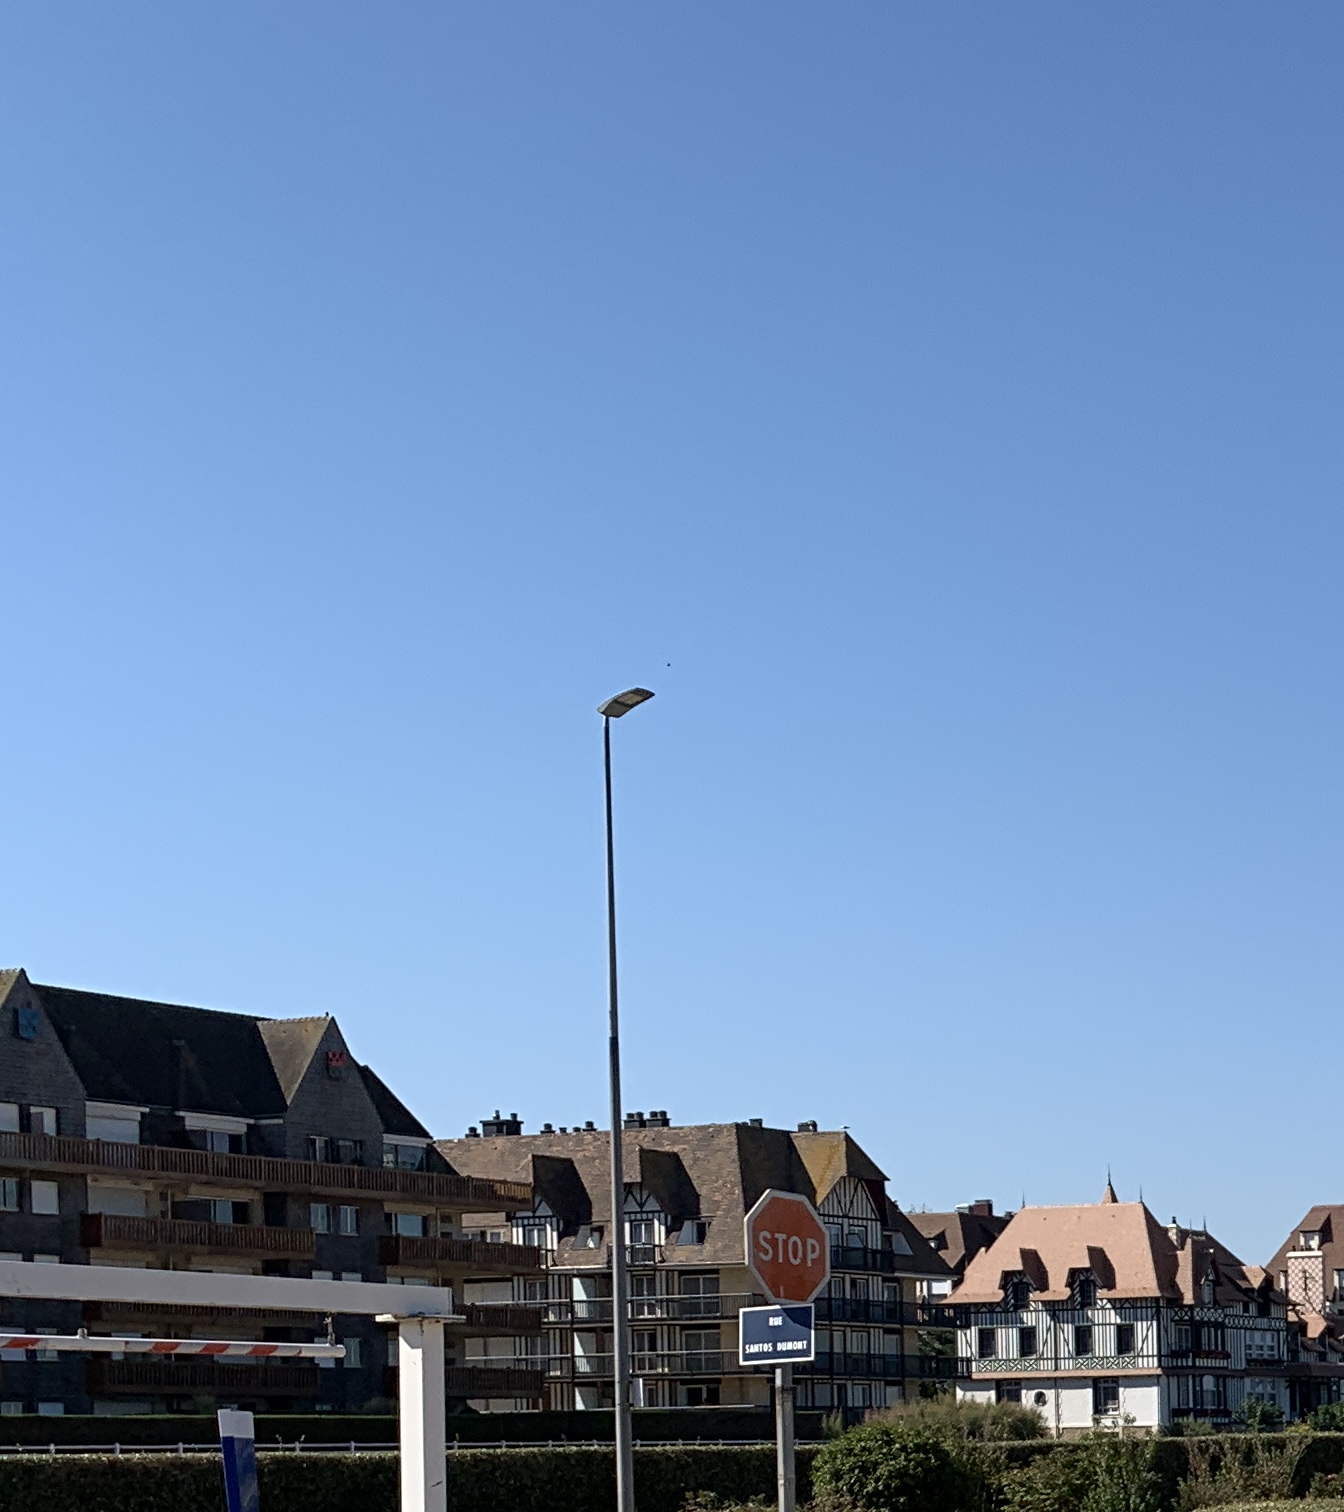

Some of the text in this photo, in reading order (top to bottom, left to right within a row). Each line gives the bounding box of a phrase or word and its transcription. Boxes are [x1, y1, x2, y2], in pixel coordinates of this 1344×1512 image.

[758, 1231, 820, 1267] STOP
[768, 1316, 783, 1326] RUE
[745, 1340, 807, 1354] SANTOS DUMONT
